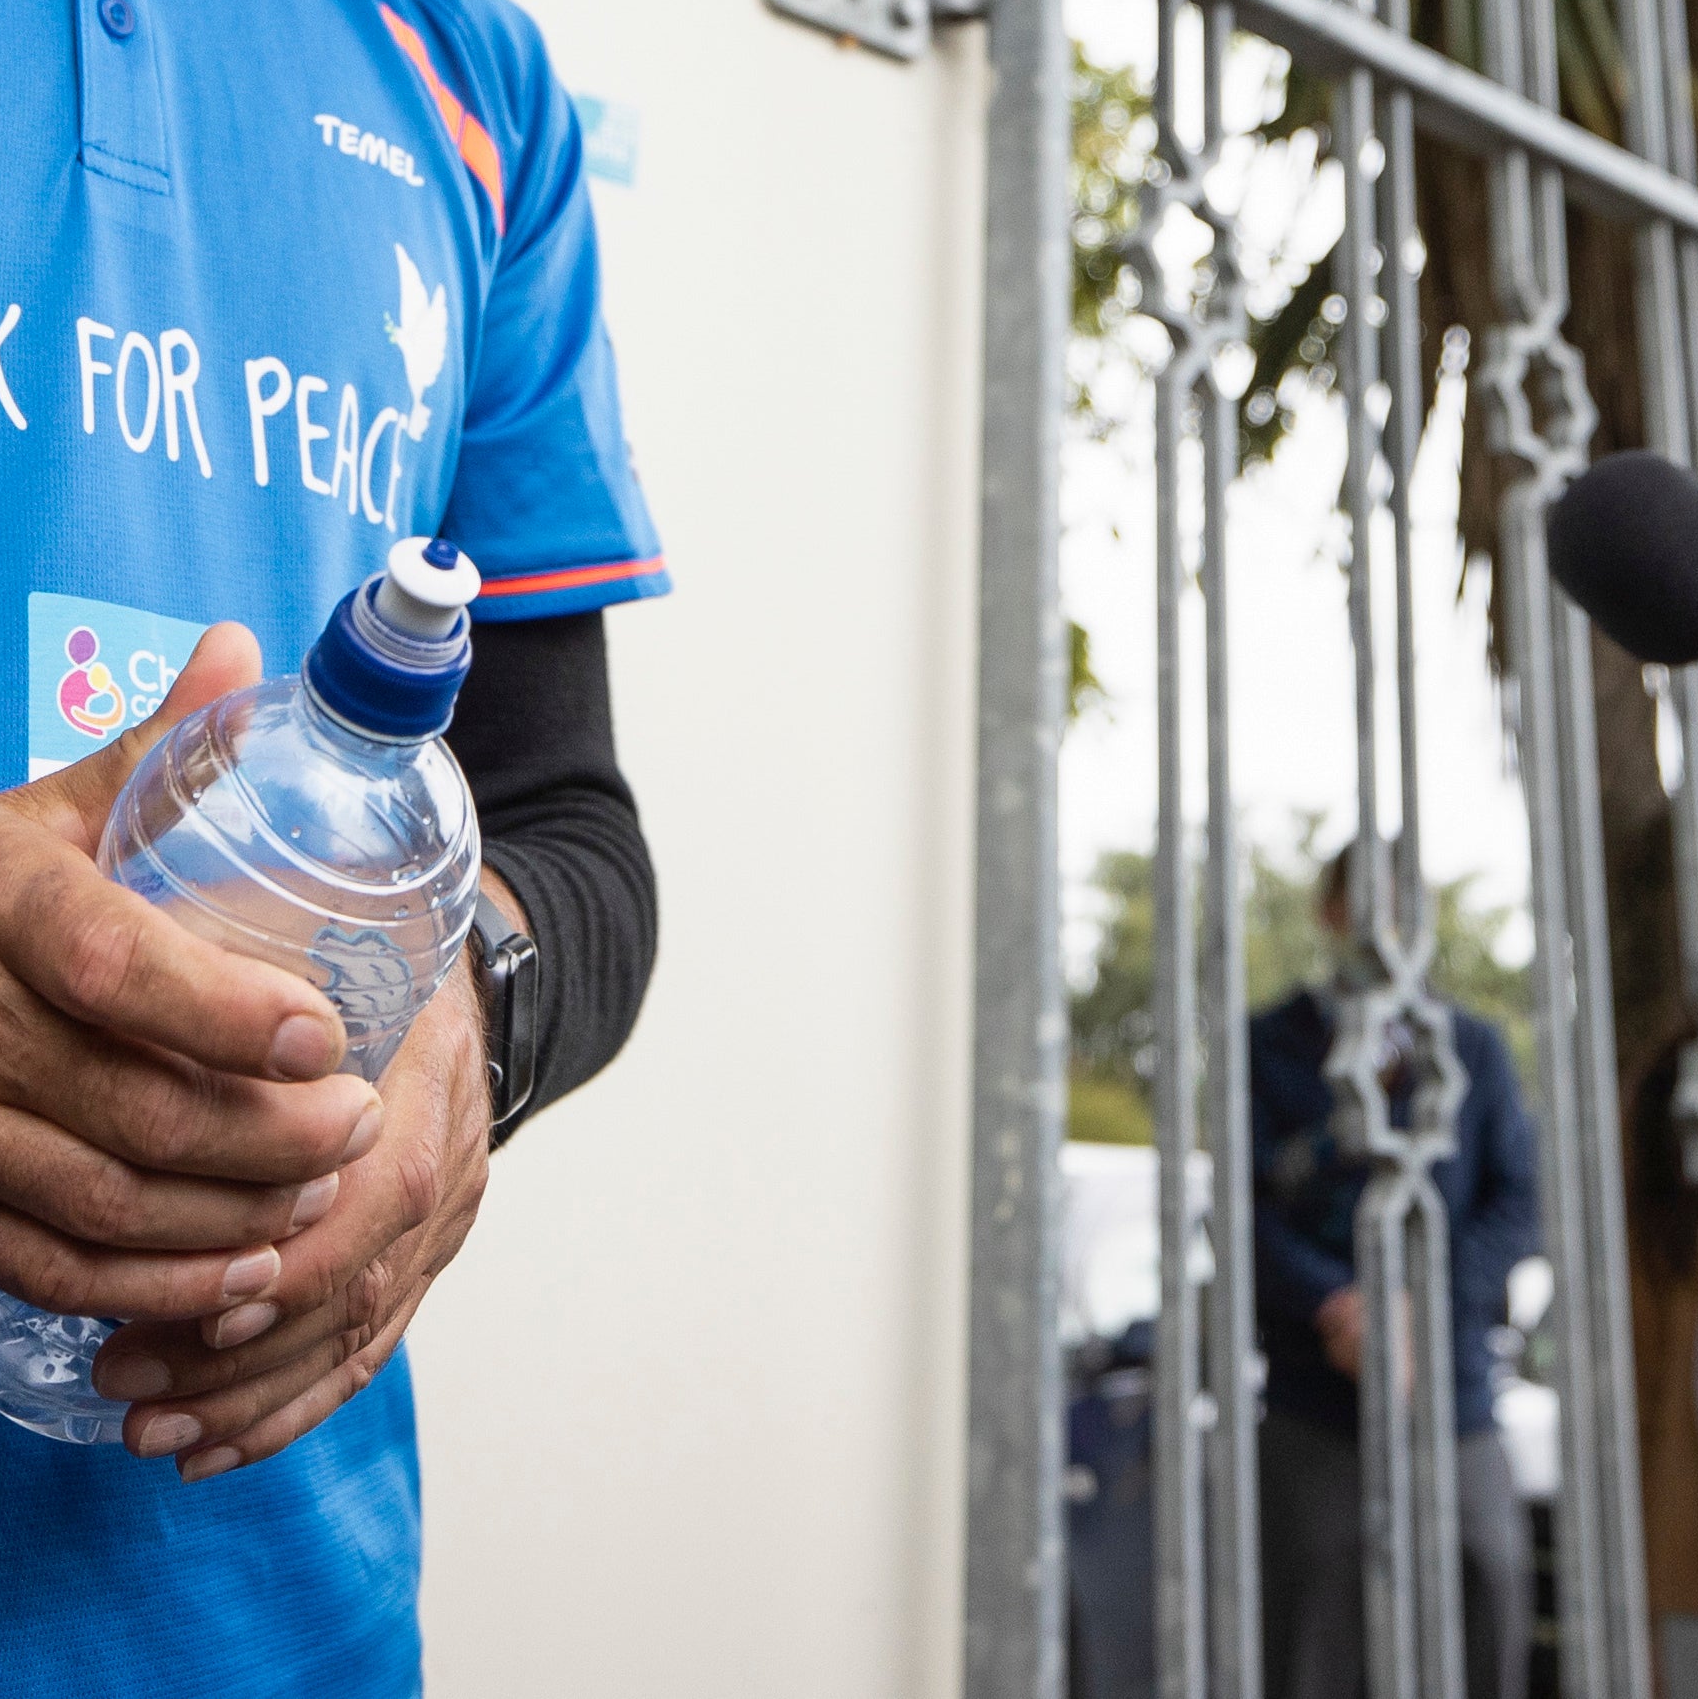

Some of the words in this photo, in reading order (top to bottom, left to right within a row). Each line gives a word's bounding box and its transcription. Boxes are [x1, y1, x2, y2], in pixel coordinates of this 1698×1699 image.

[314, 114, 425, 187] TEMEL
[75, 316, 212, 478] FOR
[244, 356, 409, 532] PEACE
